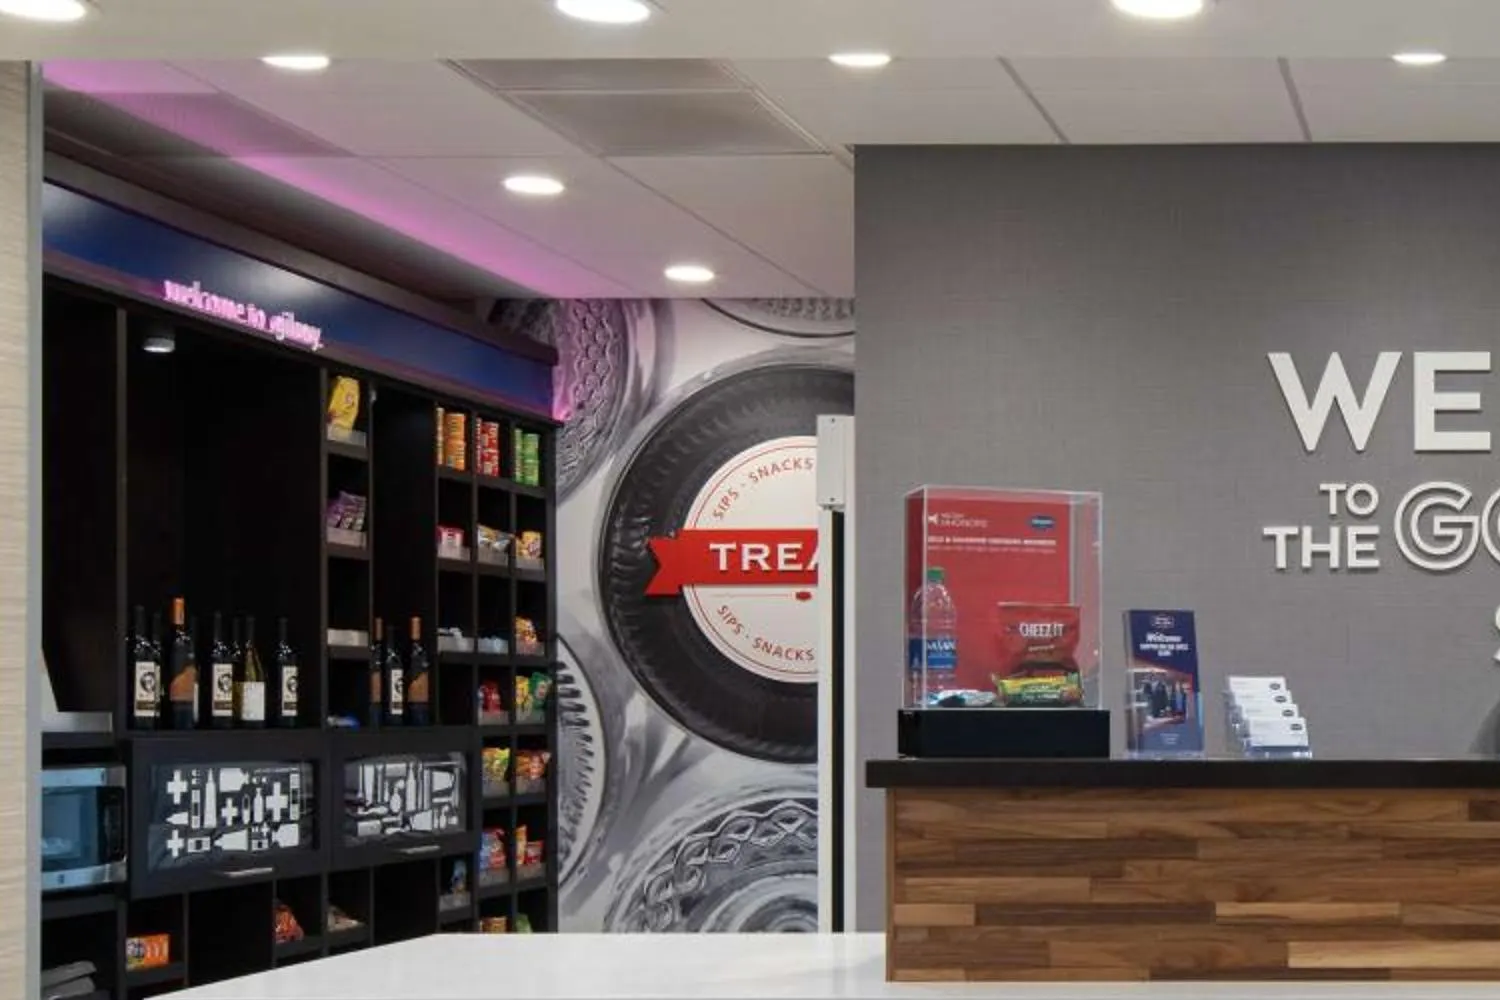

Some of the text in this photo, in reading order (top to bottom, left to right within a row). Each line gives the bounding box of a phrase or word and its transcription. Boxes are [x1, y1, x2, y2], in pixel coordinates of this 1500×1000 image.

[713, 457, 815, 519] SIPS SNACKS
[1320, 483, 1379, 515] TO
[1263, 526, 1380, 569] THE
[717, 605, 815, 661] SIPS SNACKS
